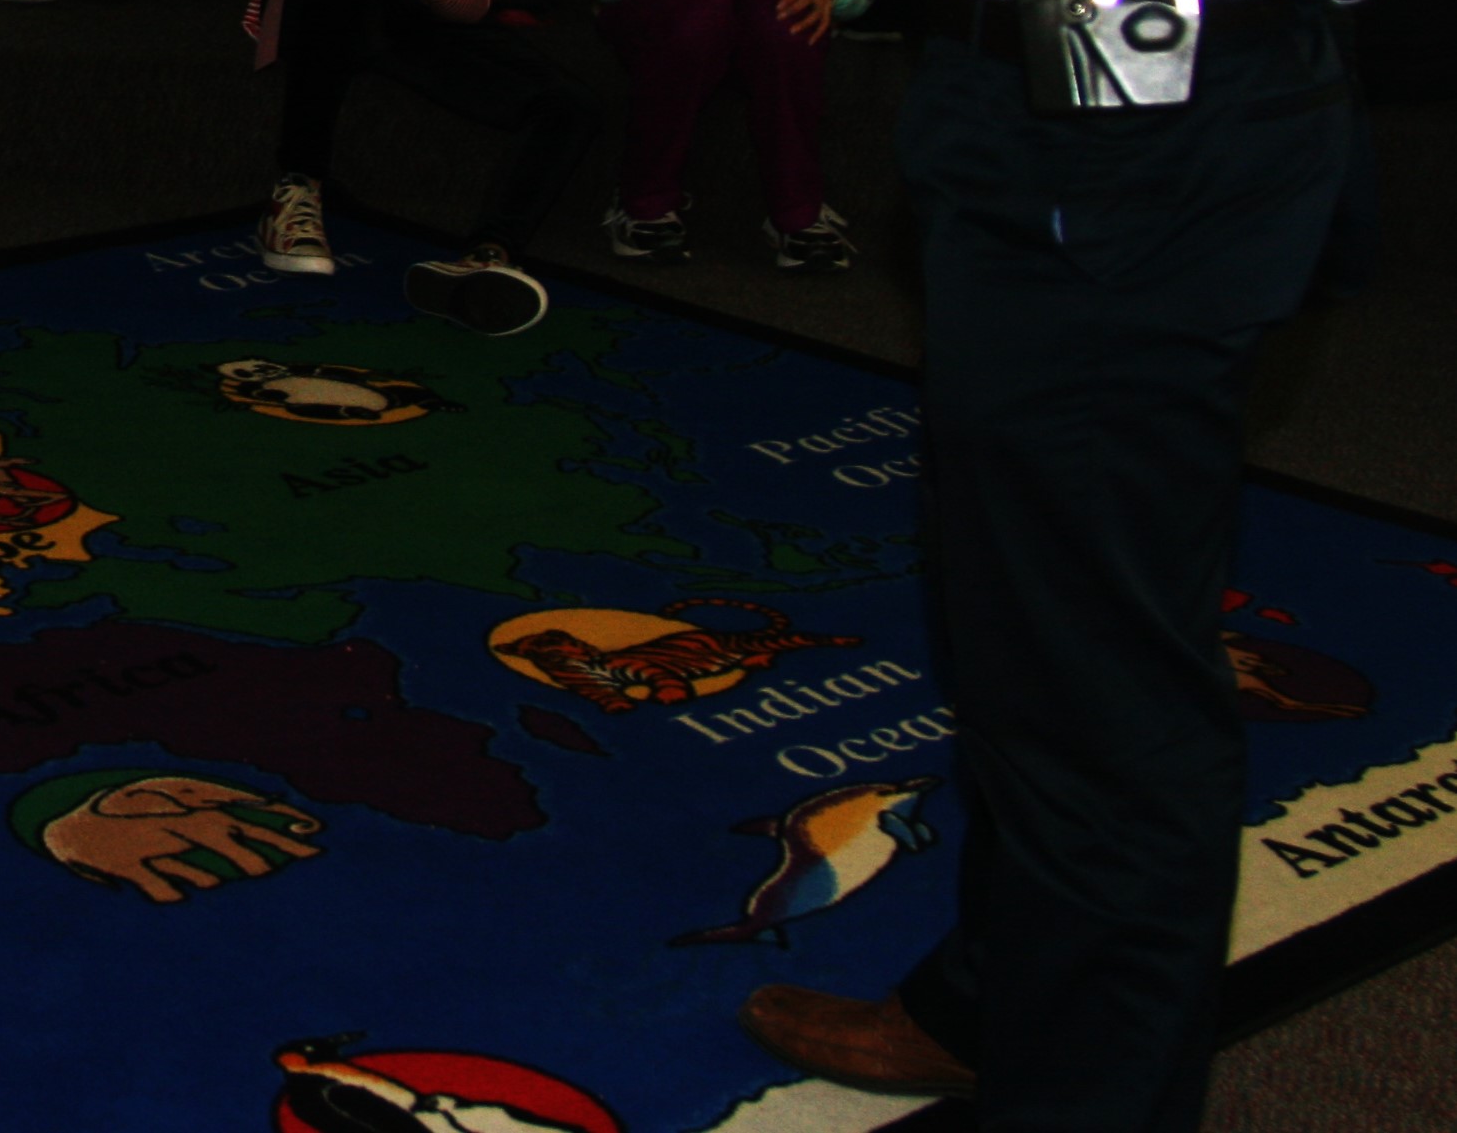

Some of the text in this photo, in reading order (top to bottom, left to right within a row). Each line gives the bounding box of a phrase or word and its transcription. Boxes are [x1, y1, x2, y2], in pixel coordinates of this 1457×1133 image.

[198, 252, 374, 292] Ocn
[744, 406, 925, 465] Pacifi
[281, 454, 429, 498] Asia
[670, 660, 923, 745] Indian
